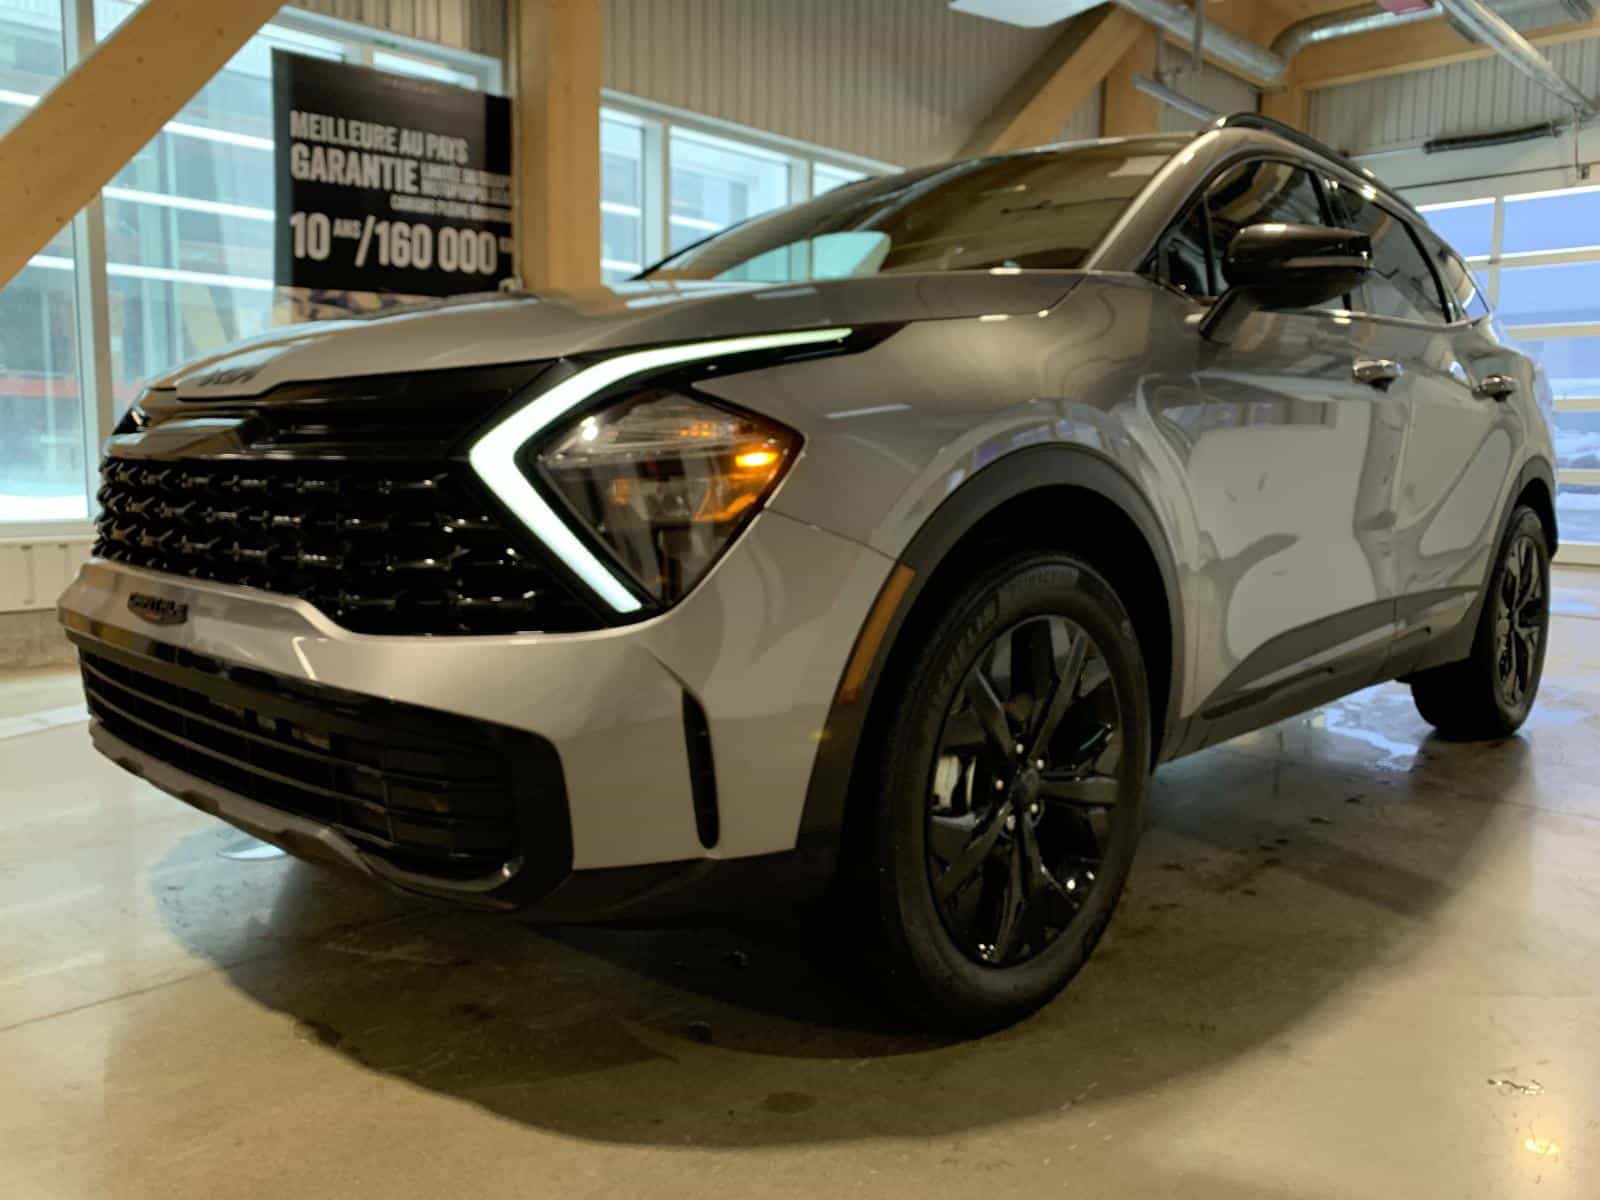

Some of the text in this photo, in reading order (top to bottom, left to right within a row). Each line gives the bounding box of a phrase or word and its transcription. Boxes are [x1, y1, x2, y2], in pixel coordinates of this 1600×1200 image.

[290, 110, 469, 164] MEILLEURE AU PAYS
[290, 142, 419, 194] GARANTIE
[290, 211, 331, 261] 10
